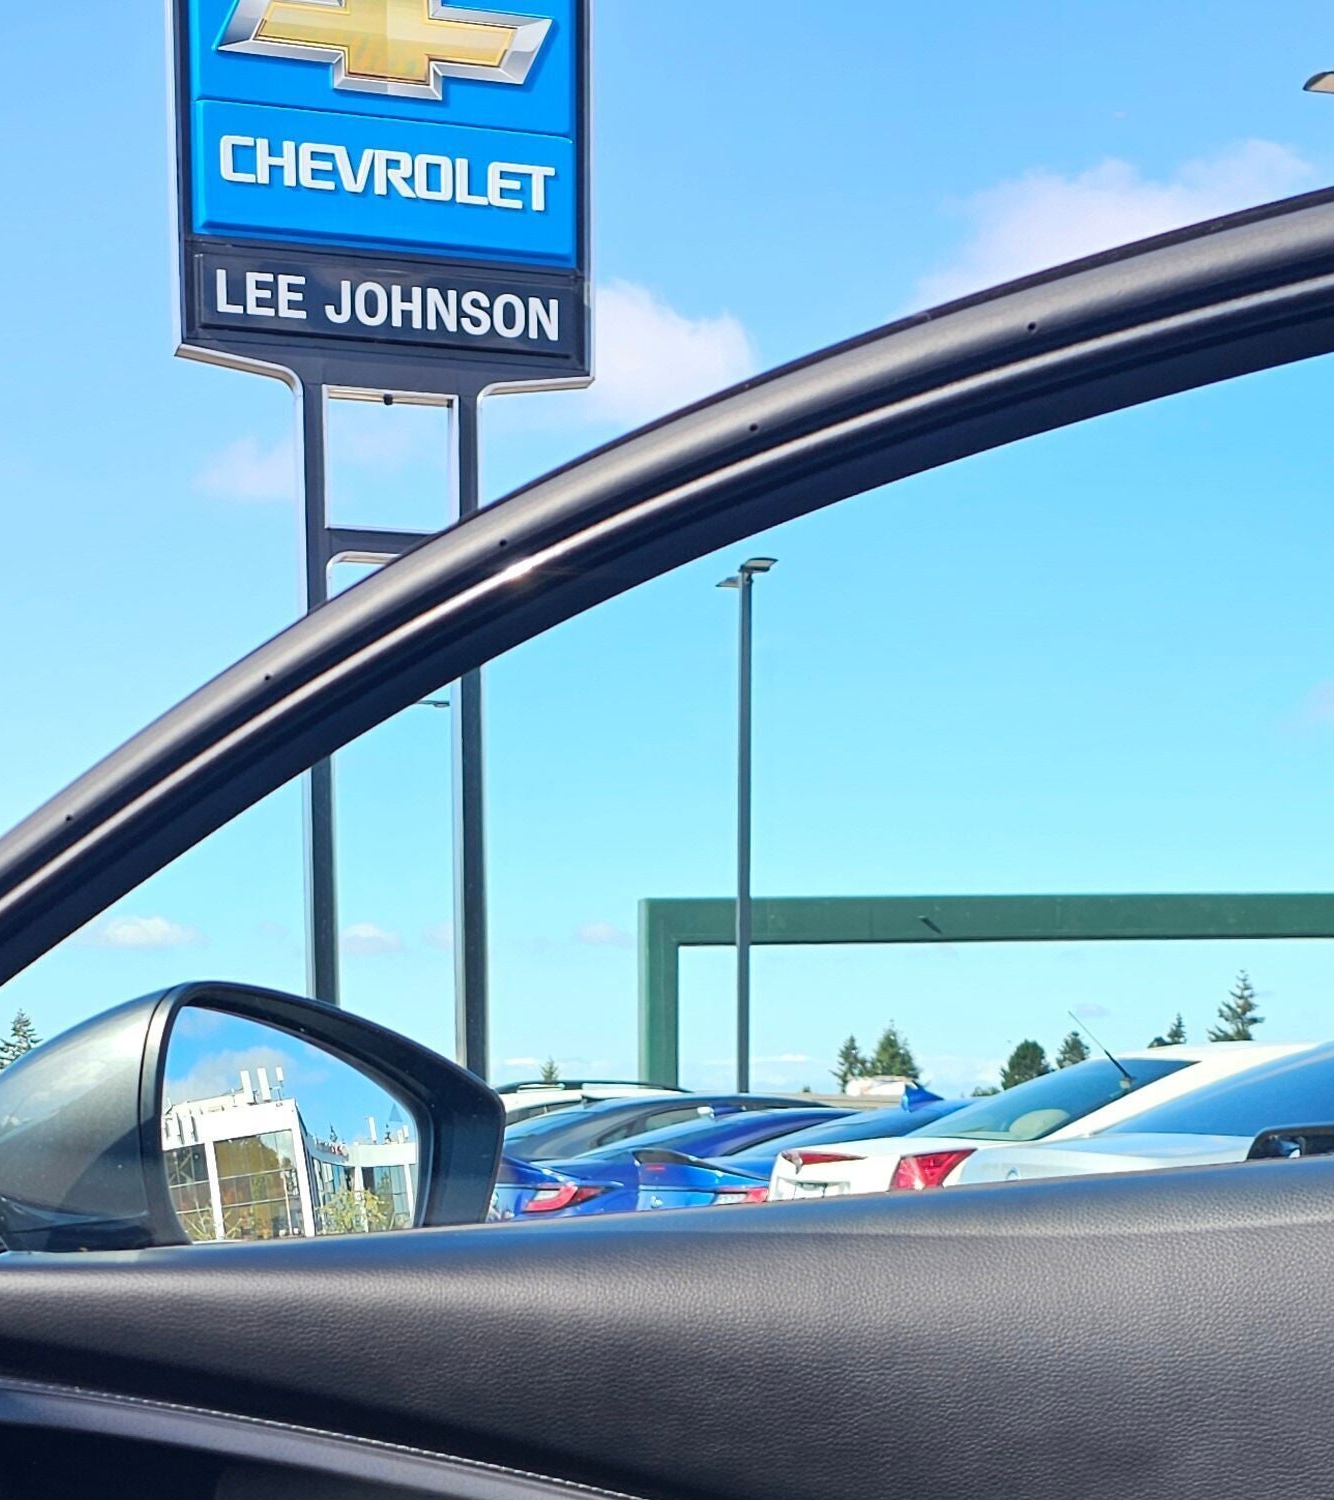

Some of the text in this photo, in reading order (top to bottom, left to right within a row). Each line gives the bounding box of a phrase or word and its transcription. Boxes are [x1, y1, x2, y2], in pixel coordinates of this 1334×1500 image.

[219, 135, 556, 212] CHEVROLET
[215, 268, 560, 341] LEE JOHNSON
